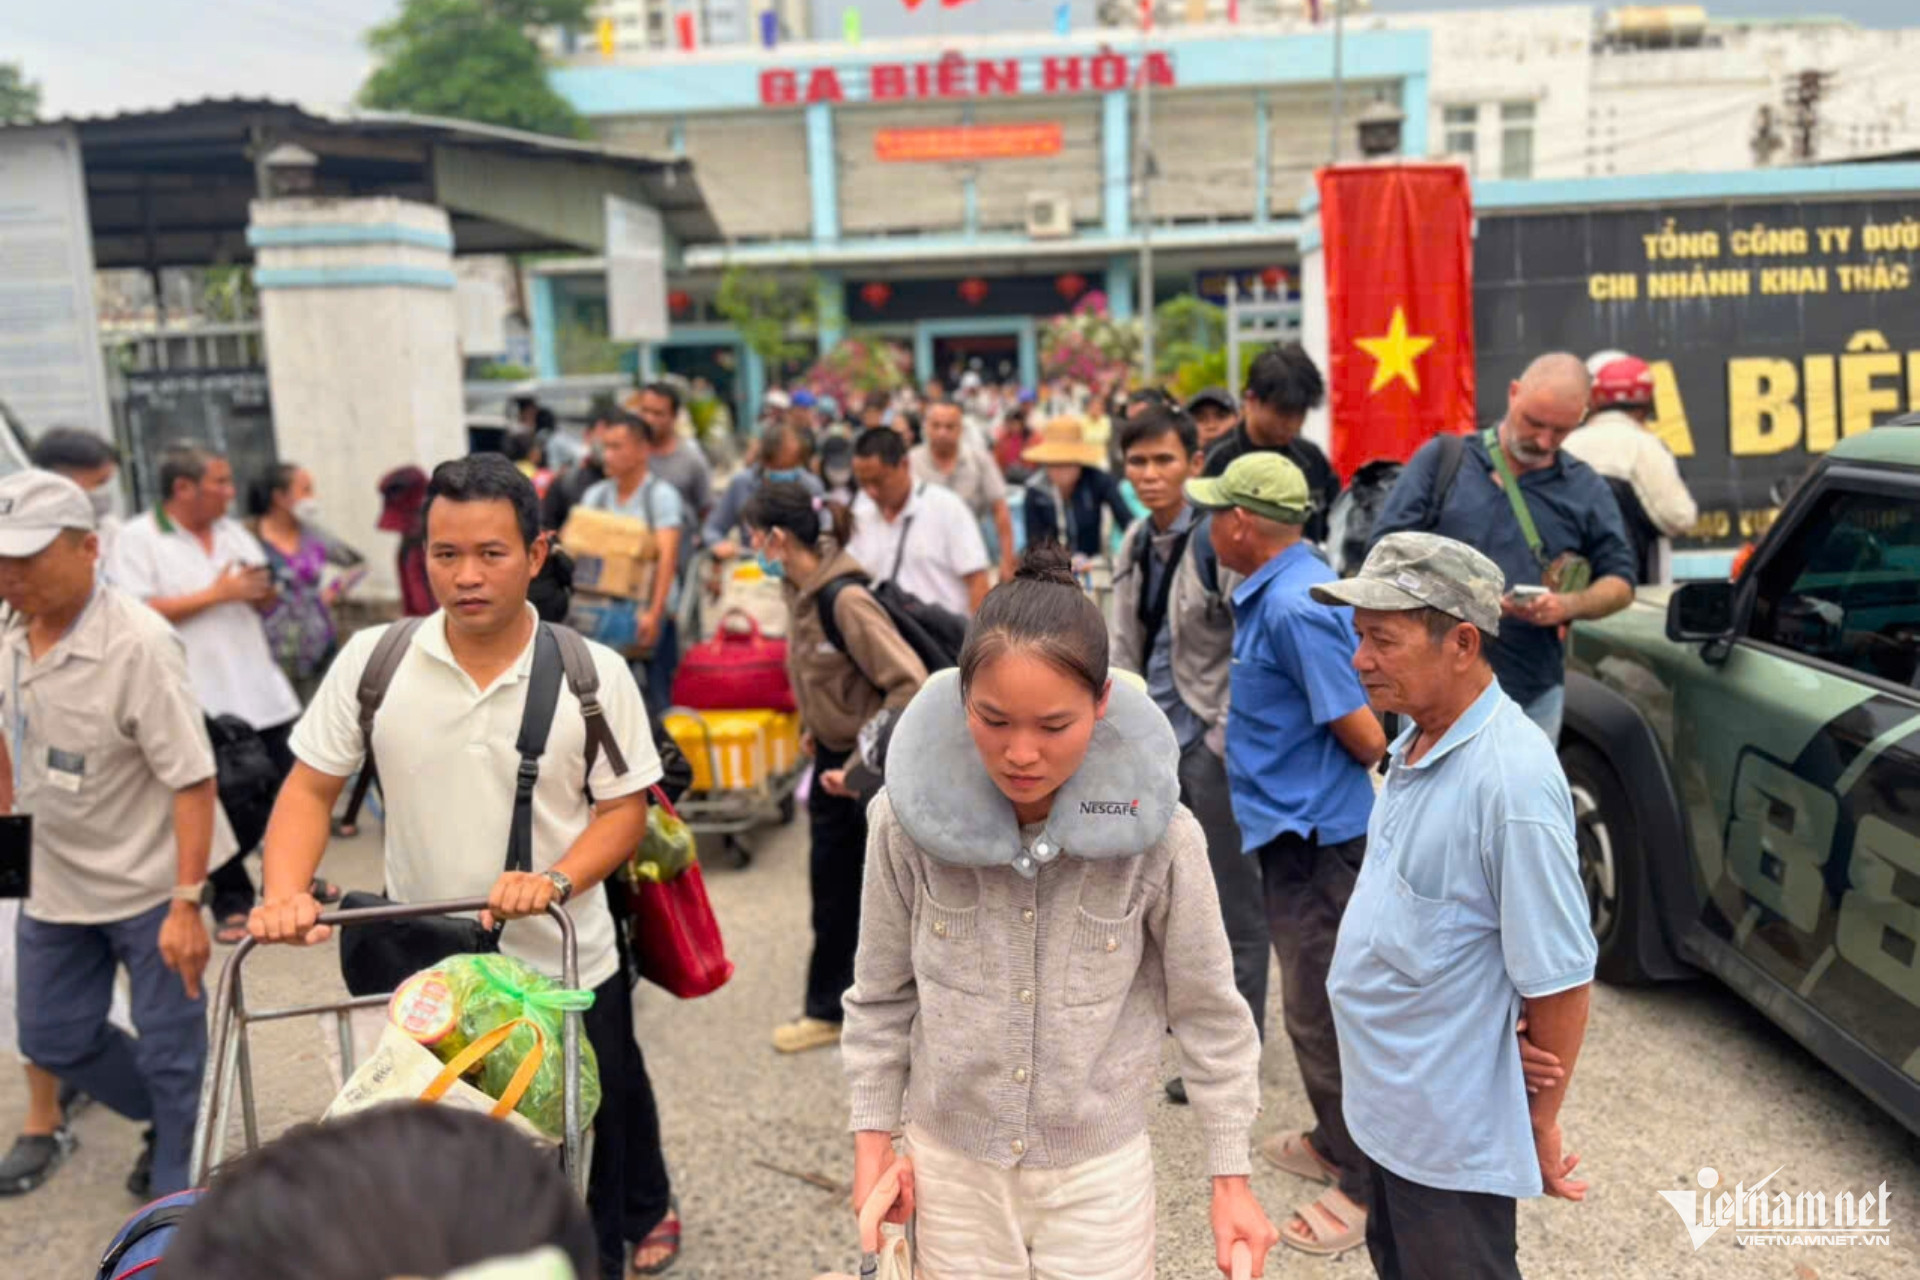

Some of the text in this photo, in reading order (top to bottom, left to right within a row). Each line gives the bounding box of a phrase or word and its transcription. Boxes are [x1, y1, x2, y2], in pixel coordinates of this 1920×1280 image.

[758, 43, 1177, 106] GA BIÊN HÒA
[1643, 217, 1719, 260] TỔNG
[1731, 222, 1808, 256] CÔNG
[1816, 226, 1852, 253] TY
[1589, 257, 1910, 300] CHI NHÁNH KHAI THÁC
[1727, 329, 1920, 456] BIÊ
